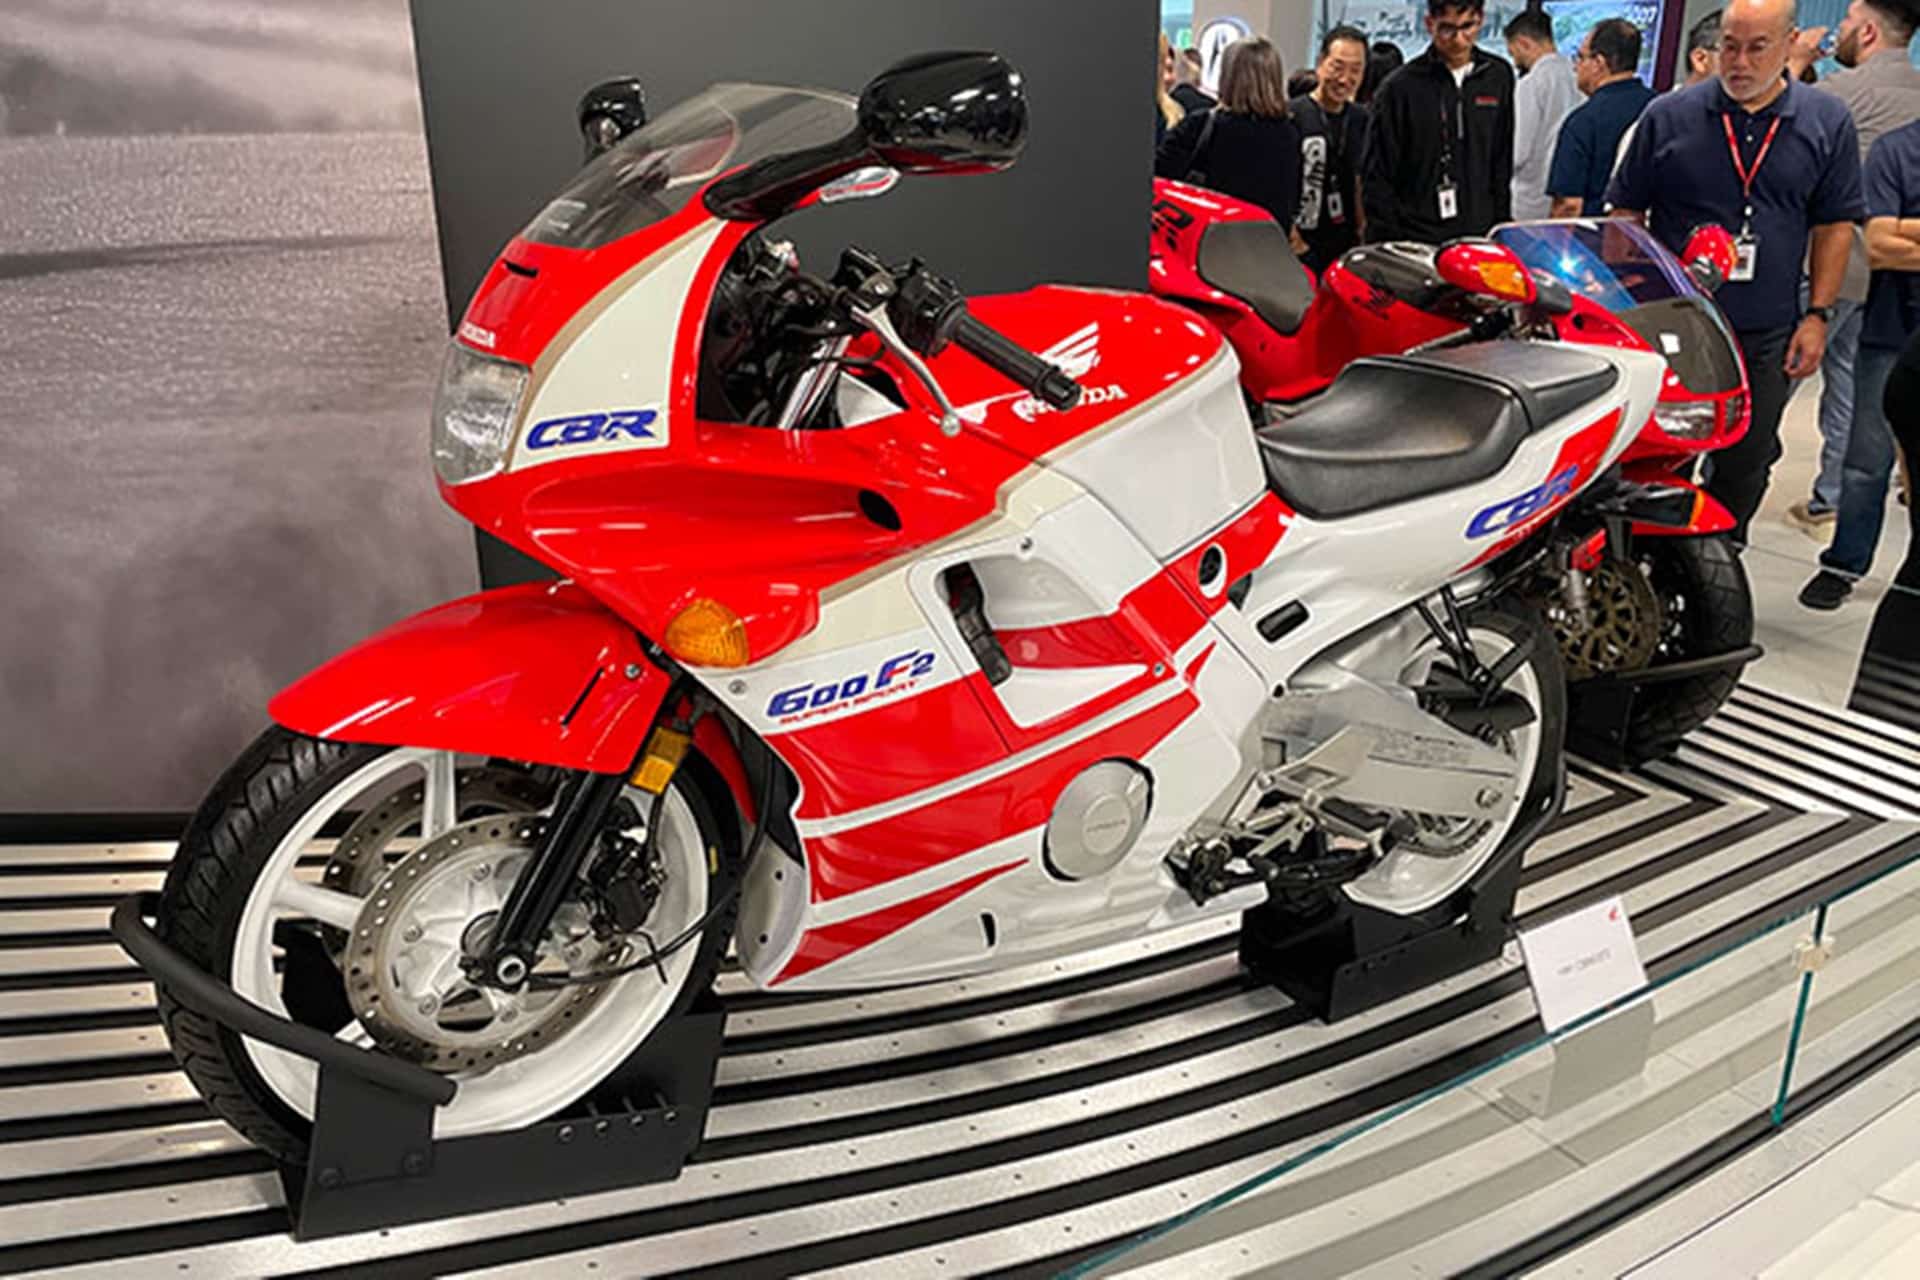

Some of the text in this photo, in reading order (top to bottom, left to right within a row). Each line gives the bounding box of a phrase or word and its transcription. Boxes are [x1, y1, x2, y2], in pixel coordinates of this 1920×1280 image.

[525, 408, 658, 450] CBR
[1011, 384, 1128, 423] HDA
[1465, 464, 1579, 539] CBR
[766, 650, 936, 718] 600 F2
